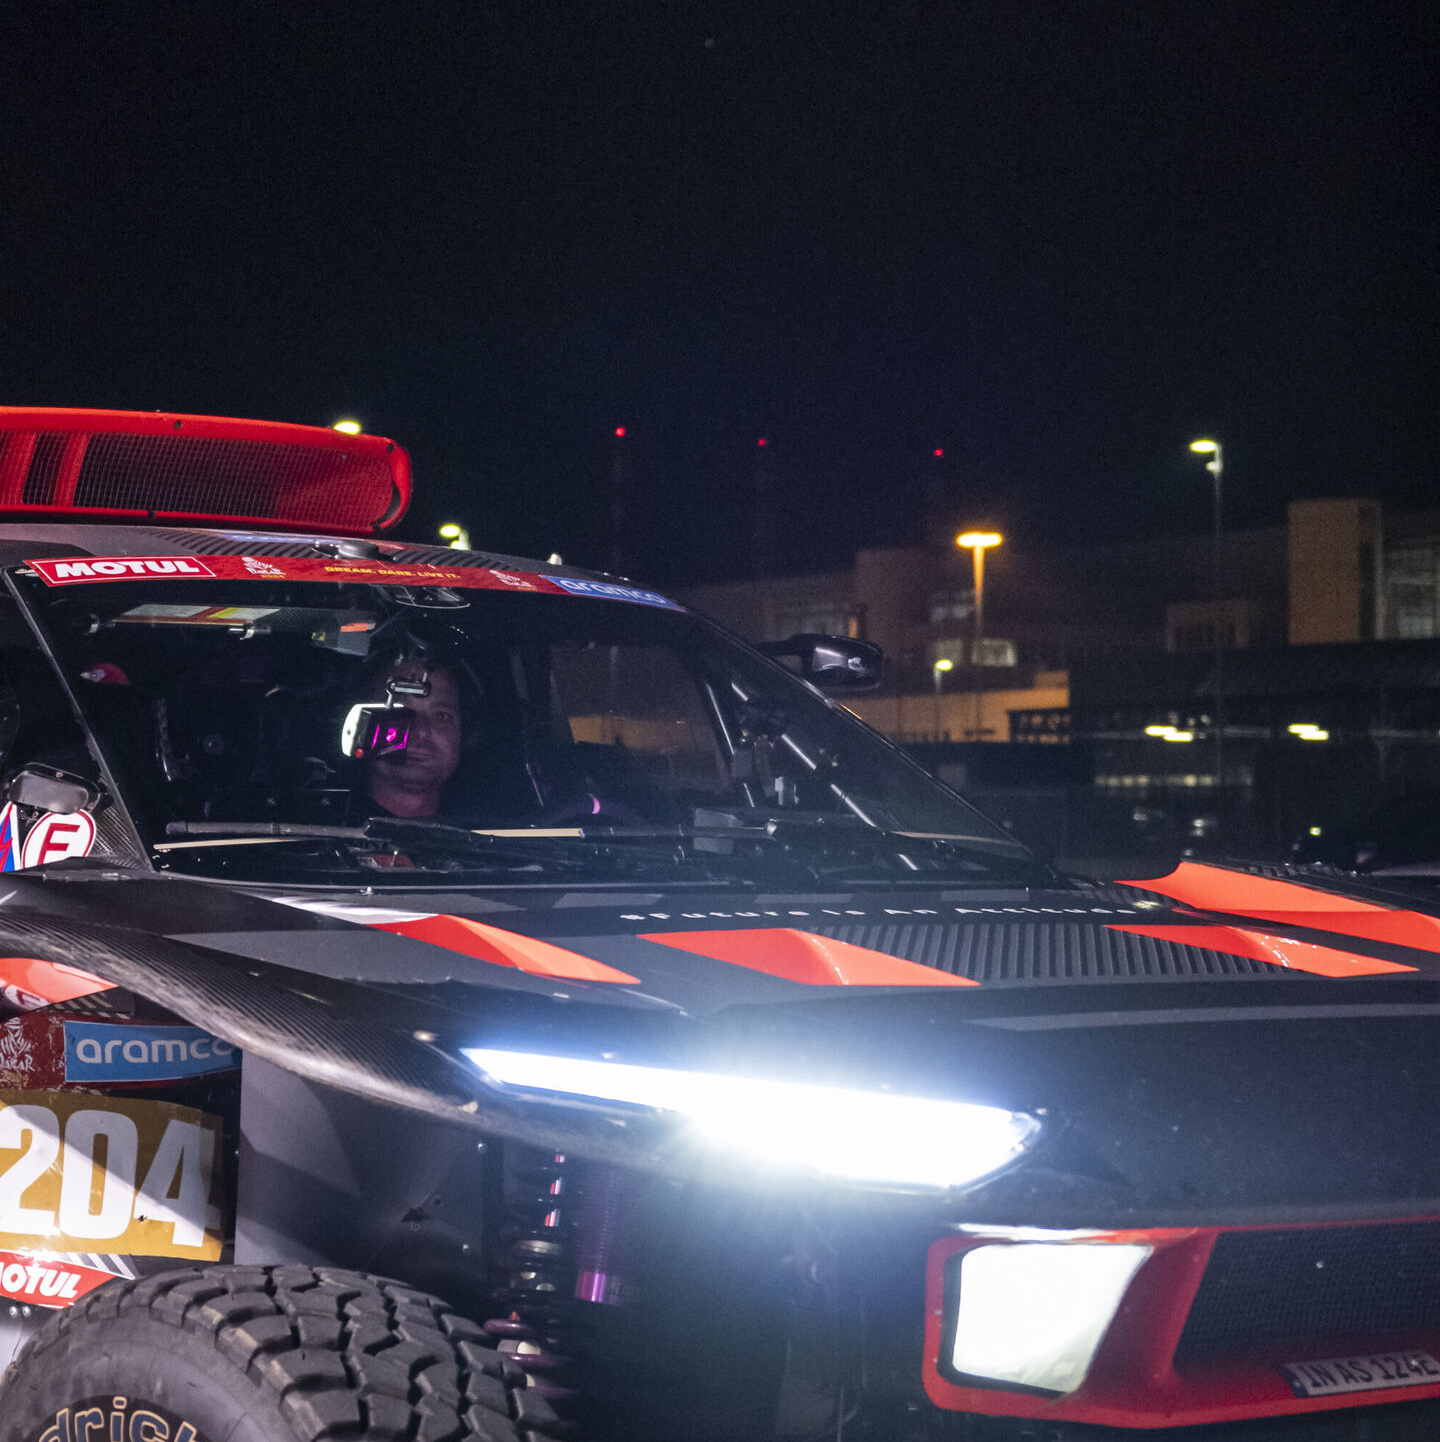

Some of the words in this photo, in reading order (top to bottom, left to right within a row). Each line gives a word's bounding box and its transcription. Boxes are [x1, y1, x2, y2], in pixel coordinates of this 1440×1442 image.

[56, 560, 200, 578] MOTUL
[324, 566, 376, 574] DREAM.
[560, 579, 667, 604] aramco
[37, 822, 81, 865] F
[1297, 1363, 1338, 1388] IN
[1333, 1360, 1373, 1384] AS
